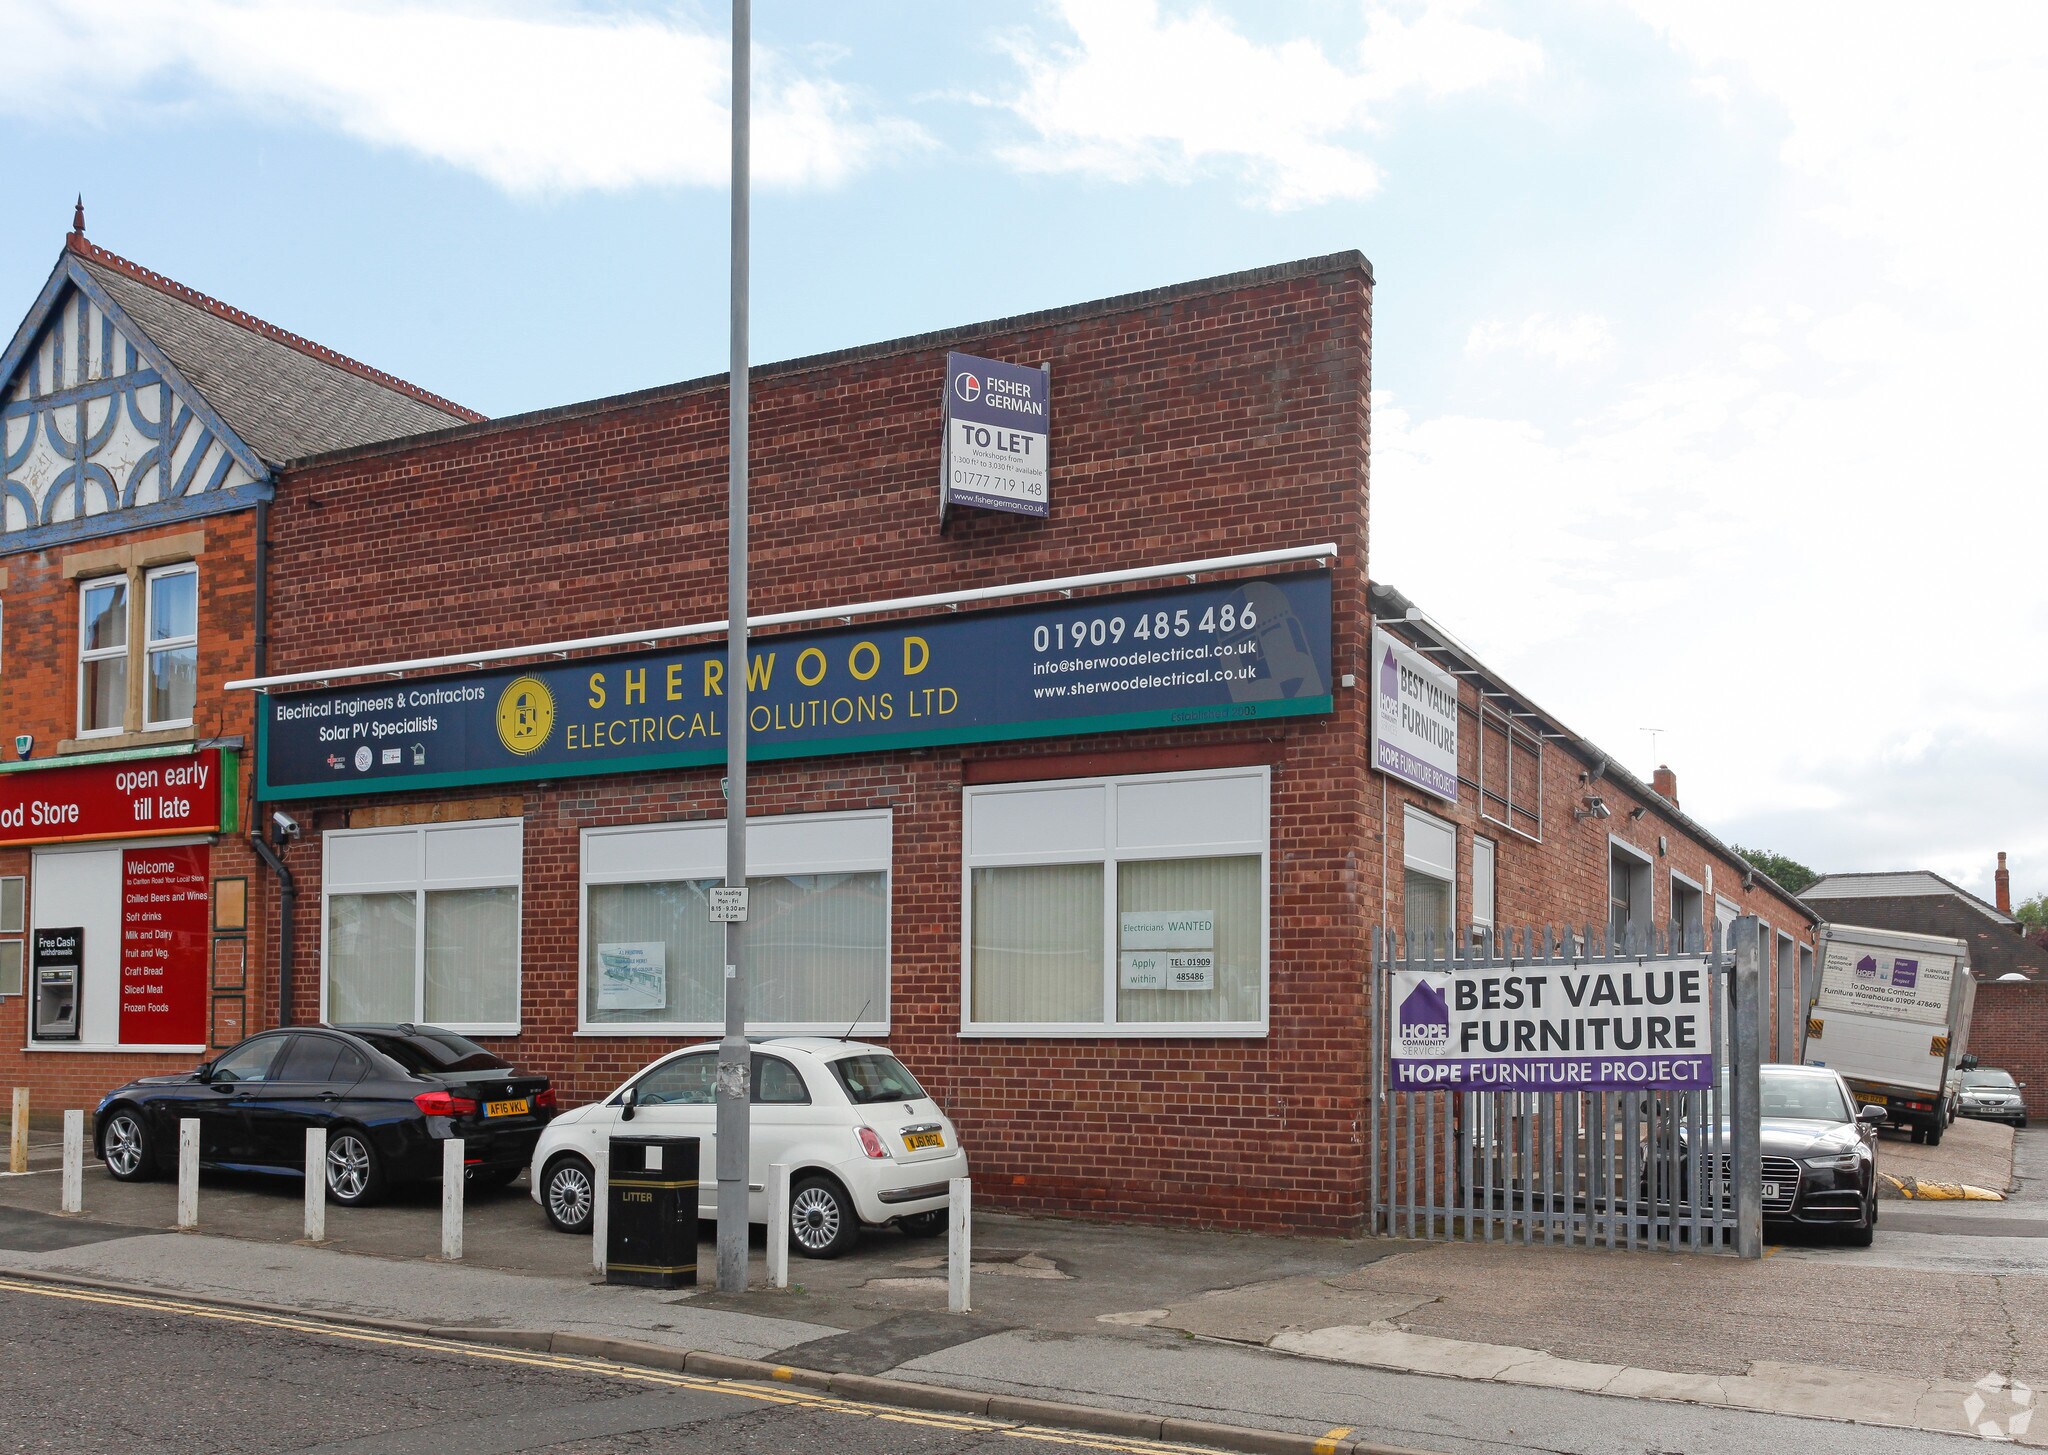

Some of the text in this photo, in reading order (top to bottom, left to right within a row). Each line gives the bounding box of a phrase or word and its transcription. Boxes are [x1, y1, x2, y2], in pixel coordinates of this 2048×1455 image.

[987, 377, 1031, 398] FISHER
[985, 394, 1042, 415] GERMAN
[962, 425, 1033, 455] TO LET
[973, 449, 1024, 464] Workshops from
[953, 456, 971, 466] 1,300
[980, 460, 987, 468] to
[1015, 466, 1043, 477] available
[954, 470, 1042, 496] 01777 719 148
[954, 493, 1044, 513] www.fishergerman.co.uk
[1033, 602, 1257, 652] 01909 485 486
[1033, 640, 1256, 675] info@sherwoodelectrical.co.uk
[588, 636, 930, 709] SHERWOOD
[1034, 665, 1256, 699] www.sherwoodelectrical.co.uk
[1401, 664, 1456, 722] BEST VALUE
[276, 686, 485, 721] Electrical Engineers & Contractors
[1232, 705, 1257, 717] 2003
[1380, 692, 1398, 717] HOPE
[567, 687, 958, 750] ELECTRICAL OLUTIONS LTD
[319, 717, 438, 742] Solar PV Specialists
[1402, 702, 1455, 755] FURNITURE
[1380, 744, 1456, 795] HOPE FURNITURE PROJECT
[116, 762, 209, 795] open early
[31, 801, 79, 826] Store
[134, 796, 190, 820] till late
[127, 861, 175, 875] Welcome
[126, 891, 208, 903] Chilled Beers and Wines
[126, 912, 162, 922] Soft drinks
[125, 929, 173, 940] Milk and Dairy
[1123, 921, 1212, 932] Electricians WANTED
[38, 937, 76, 948] Free Cash
[40, 948, 73, 956] withdrawals
[125, 948, 170, 959] fruit and Veg.
[1132, 958, 1156, 969] Apply
[1170, 958, 1211, 966] TEL: 01909
[125, 966, 163, 976] Craft Bread
[1130, 974, 1157, 984] within
[1176, 972, 1204, 980] 485486
[1857, 969, 1876, 977] HOPE
[1924, 974, 1950, 982] REMOVALS
[124, 984, 163, 994] Sliced Meat
[1455, 970, 1700, 1011] BEST VALUE
[1860, 984, 1886, 994] Donate
[1887, 988, 1917, 998] Contact
[1824, 987, 1942, 1009] Furniture Warehouse 01909 478690
[124, 1002, 169, 1012] Frozen Foods
[1401, 1023, 1447, 1039] HOPE
[1460, 1015, 1696, 1053] FURNITURE
[1402, 1039, 1446, 1047] COMMUNITY
[1402, 1047, 1446, 1056] SERVICES
[1399, 1060, 1702, 1084] HOPE FURNITURE PROJECT
[490, 1101, 526, 1115] AF16 VKL
[622, 1191, 653, 1202] LITTER
